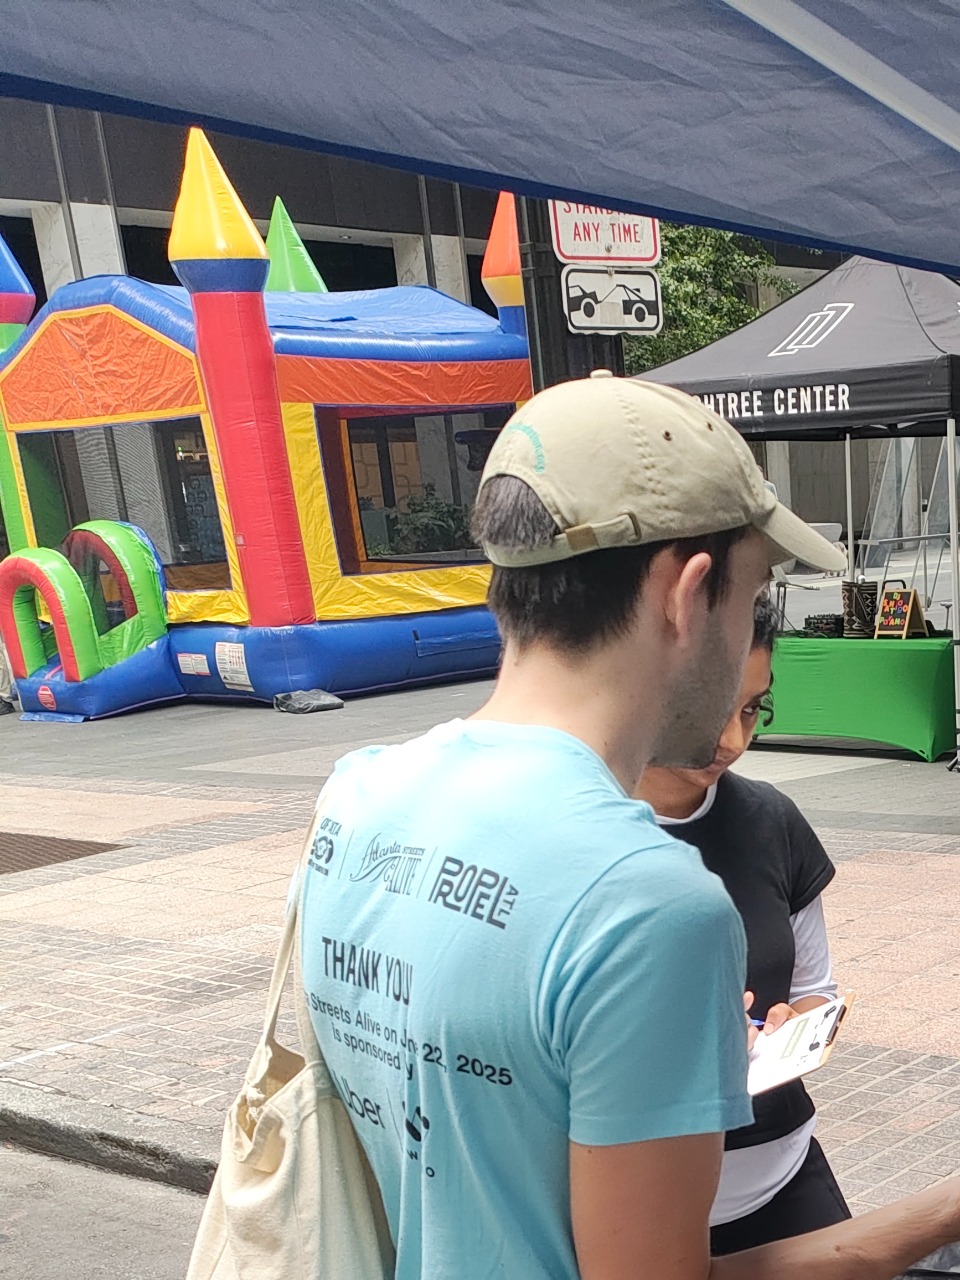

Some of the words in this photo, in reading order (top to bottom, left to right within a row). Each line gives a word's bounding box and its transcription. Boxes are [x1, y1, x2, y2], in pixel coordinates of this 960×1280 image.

[573, 222, 600, 242] ANY
[610, 223, 641, 243] TIME
[693, 390, 763, 419] HTREE
[773, 383, 850, 415] CENTER
[322, 936, 381, 993] THANK
[385, 955, 413, 1006] YOU
[310, 992, 352, 1025] Streets
[355, 1010, 381, 1036] Alive
[384, 1028, 398, 1045] on
[456, 1054, 513, 1086] 2025
[332, 1021, 342, 1043] is
[344, 1032, 400, 1070] sponsored
